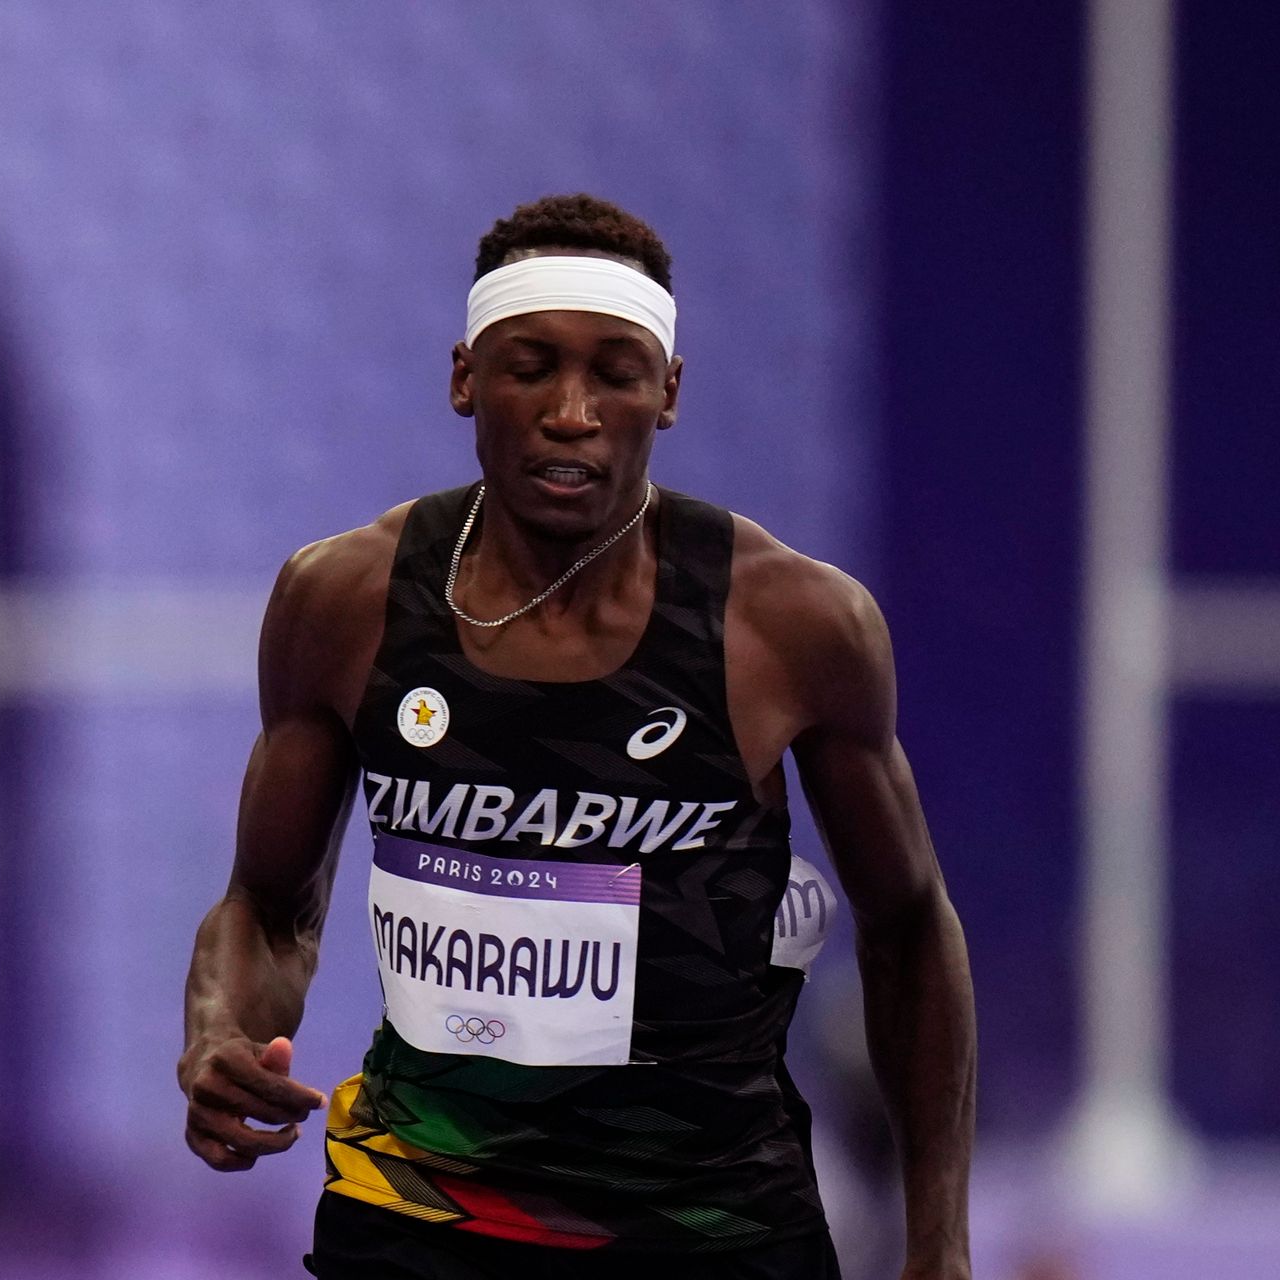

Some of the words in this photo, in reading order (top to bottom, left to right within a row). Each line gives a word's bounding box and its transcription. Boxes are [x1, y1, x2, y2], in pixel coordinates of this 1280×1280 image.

[366, 771, 738, 853] ZIMBABWE
[490, 868, 557, 889] 2024
[373, 903, 621, 1001] MAKARAWU
